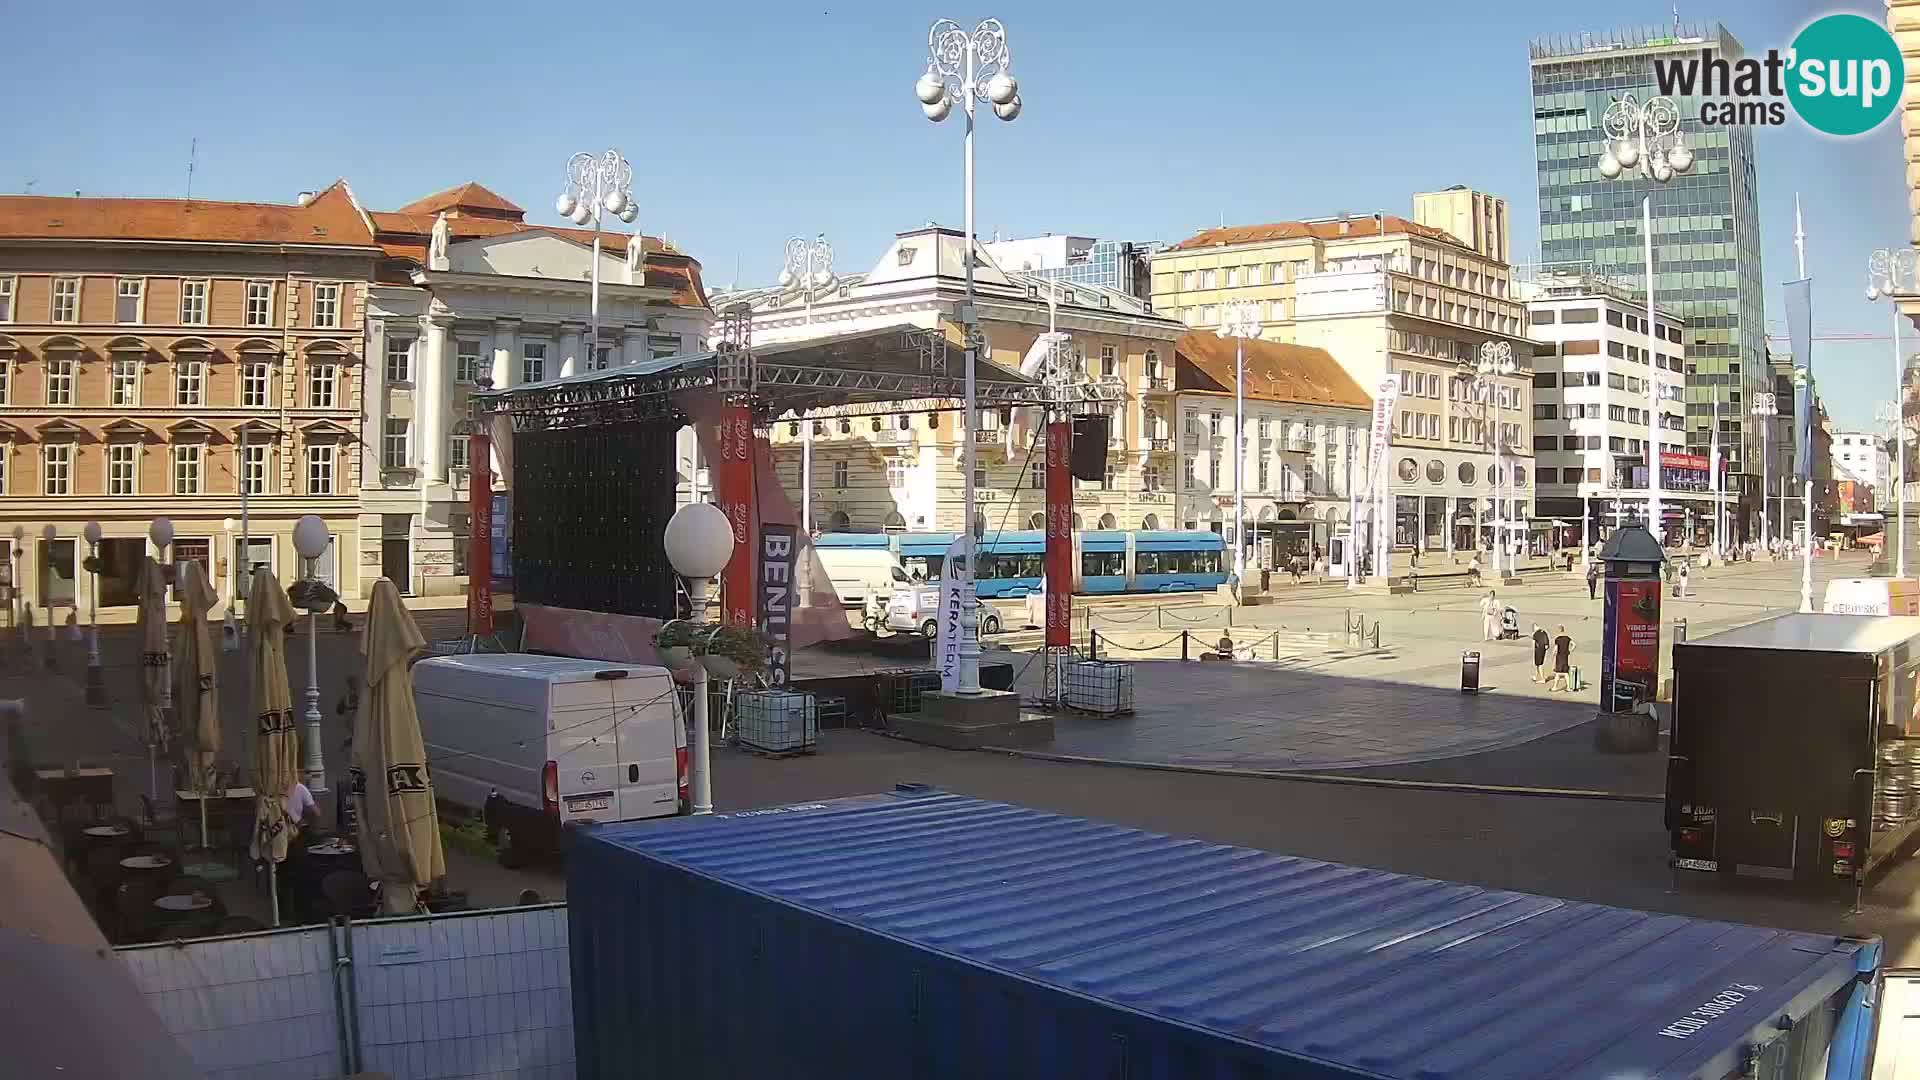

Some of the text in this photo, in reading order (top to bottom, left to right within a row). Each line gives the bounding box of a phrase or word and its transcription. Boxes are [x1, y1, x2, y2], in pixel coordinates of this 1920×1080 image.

[735, 416, 748, 460] Coca-Cola
[735, 501, 748, 545] Coca-Cola
[942, 587, 961, 678] KERATERM
[1691, 990, 1747, 1019] 300629
